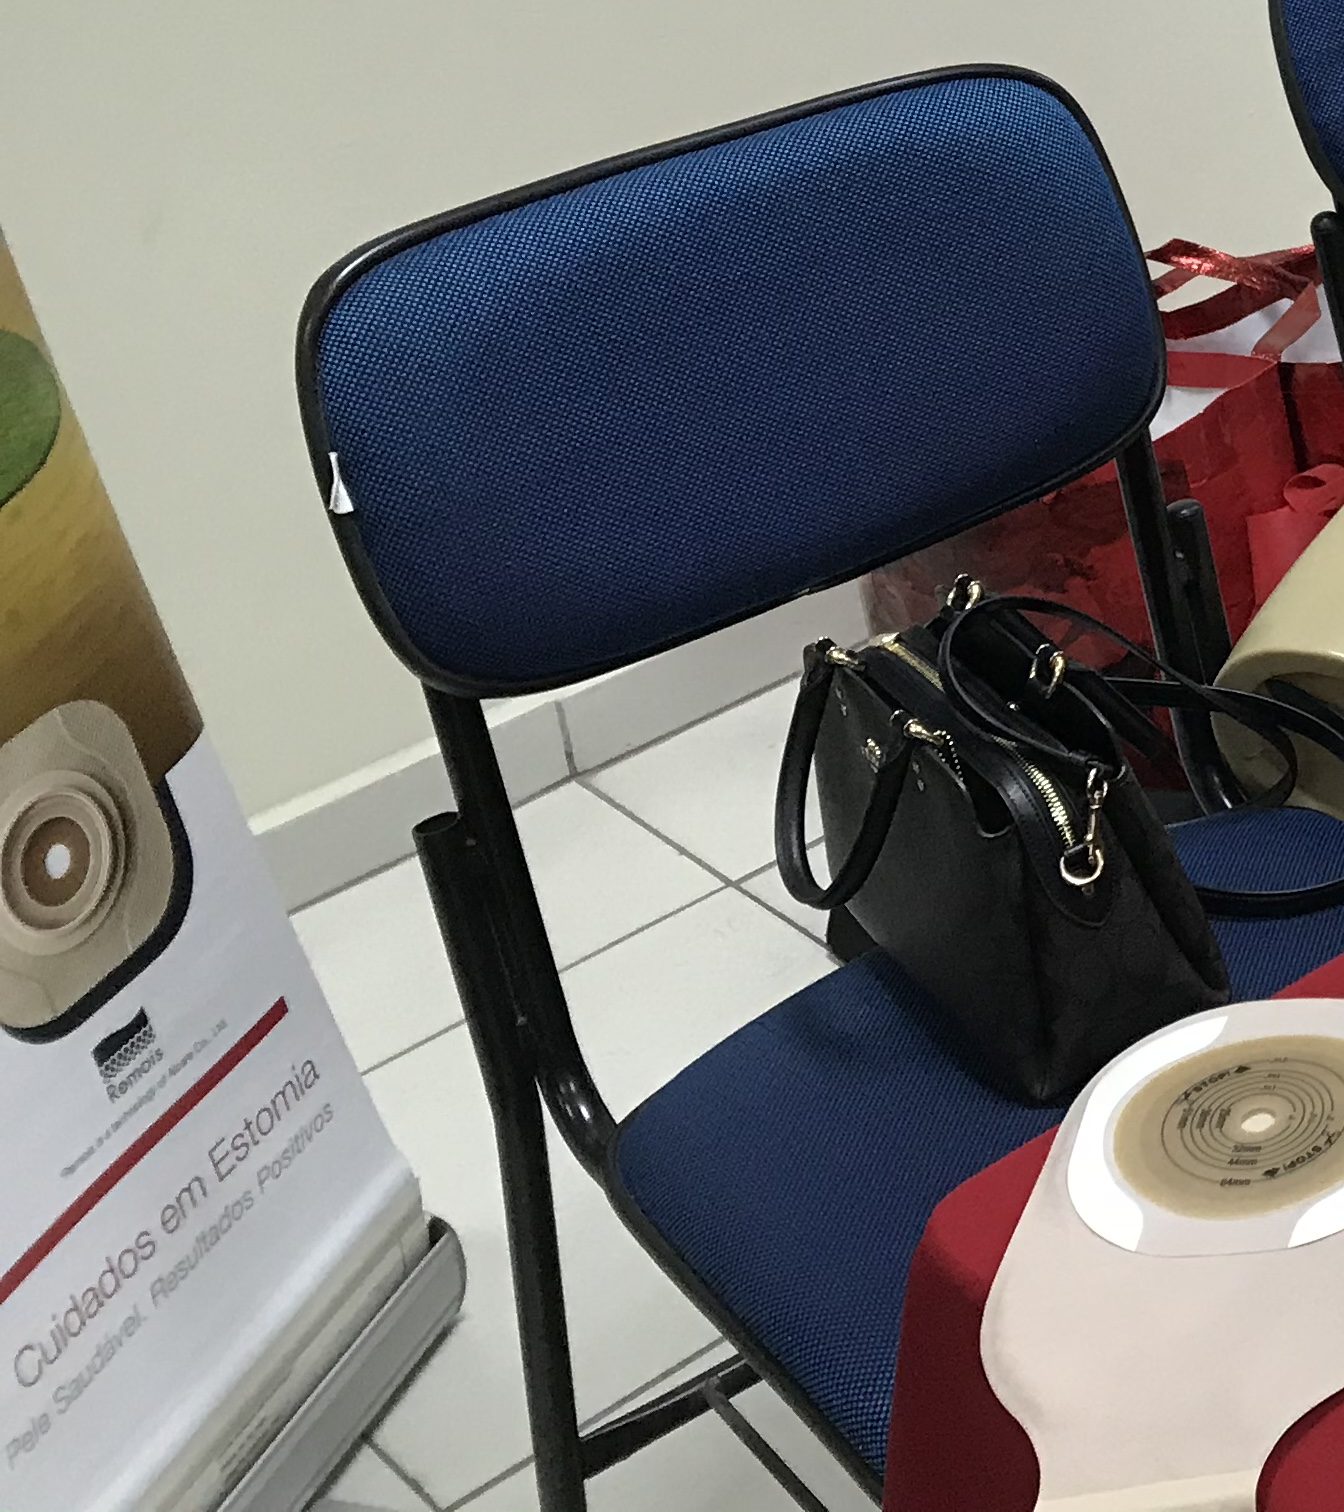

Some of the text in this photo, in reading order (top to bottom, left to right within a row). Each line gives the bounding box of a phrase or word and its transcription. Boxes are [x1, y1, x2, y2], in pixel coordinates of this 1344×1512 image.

[4, 1412, 51, 1471] Pele
[149, 1189, 255, 1310] Resultados
[255, 1102, 335, 1195] Positivos
[14, 1230, 156, 1388] Cuidados
[160, 1175, 208, 1234] em
[208, 1059, 320, 1182] Estomia
